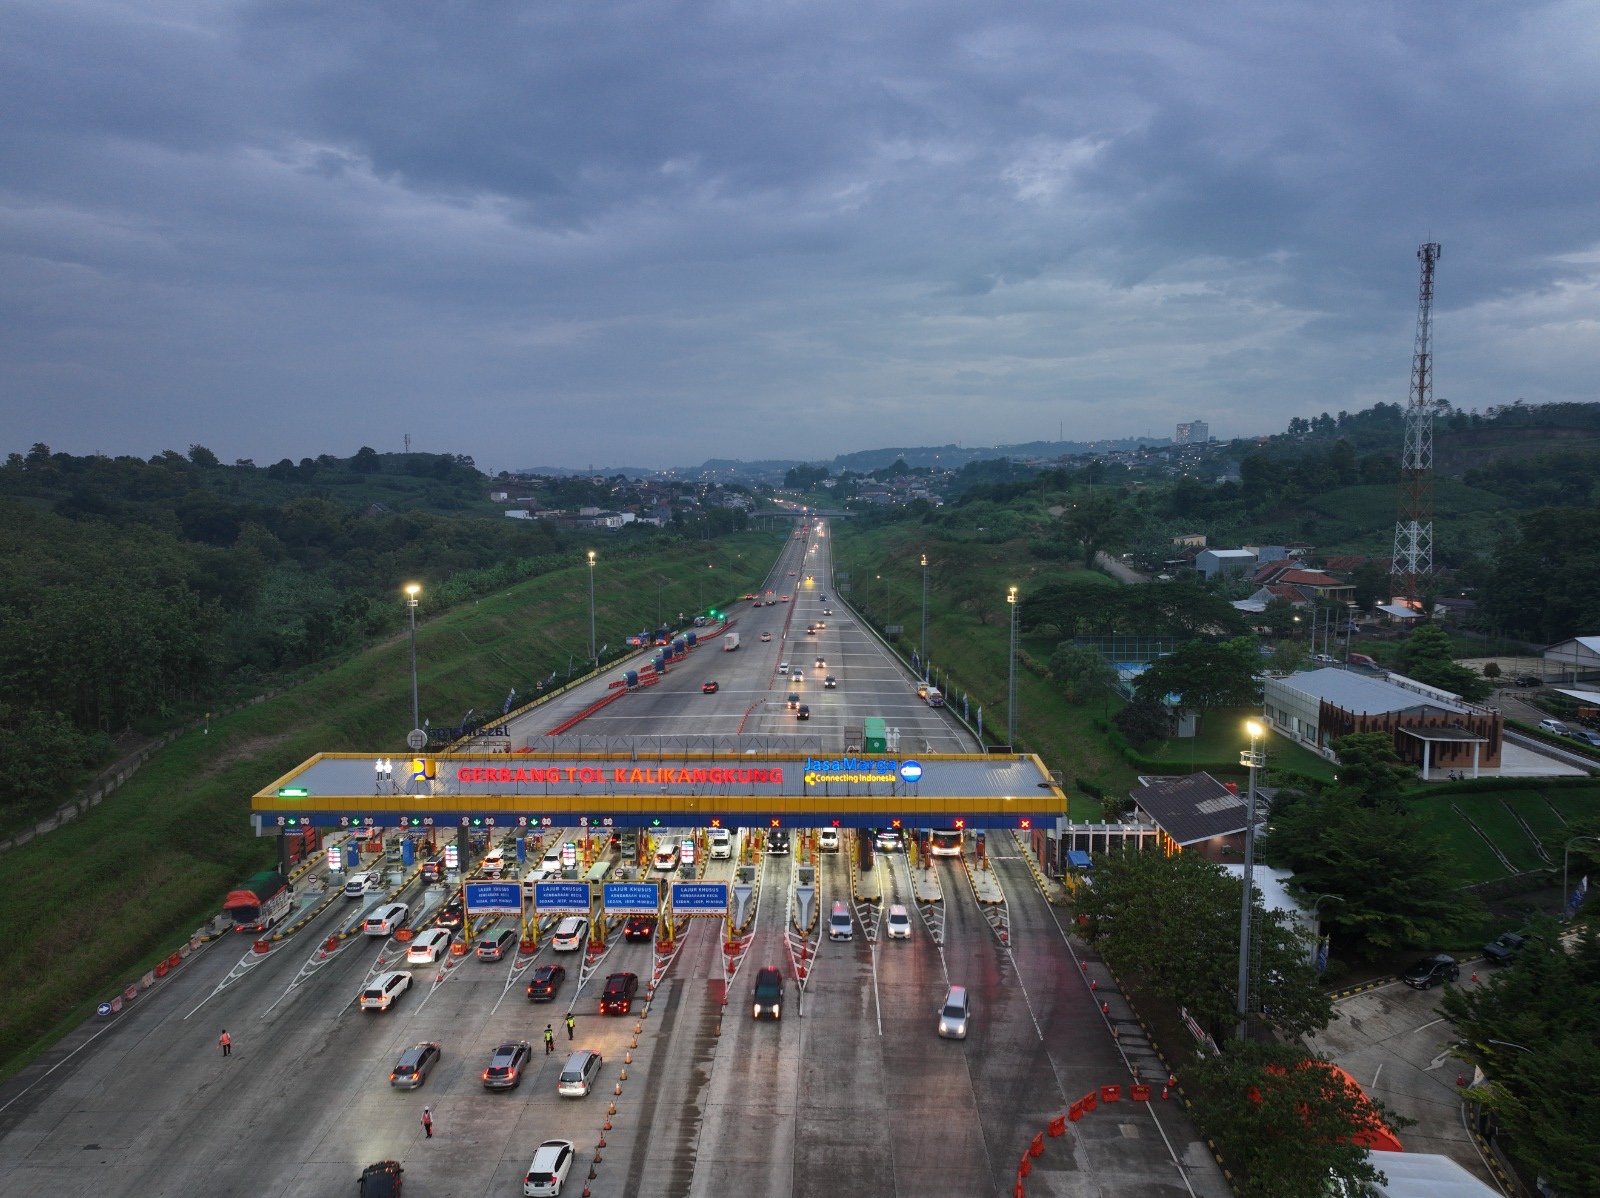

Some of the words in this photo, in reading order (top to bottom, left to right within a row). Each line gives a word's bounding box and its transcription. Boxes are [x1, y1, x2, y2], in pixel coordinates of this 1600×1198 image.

[803, 757, 840, 772] Jasa
[843, 757, 897, 774] Marga
[456, 767, 560, 784] GERBANG
[564, 767, 606, 784] TOL
[614, 768, 784, 784] KALIKANGKUNG
[815, 774, 859, 784] Connecting
[860, 774, 896, 782] Indonesia
